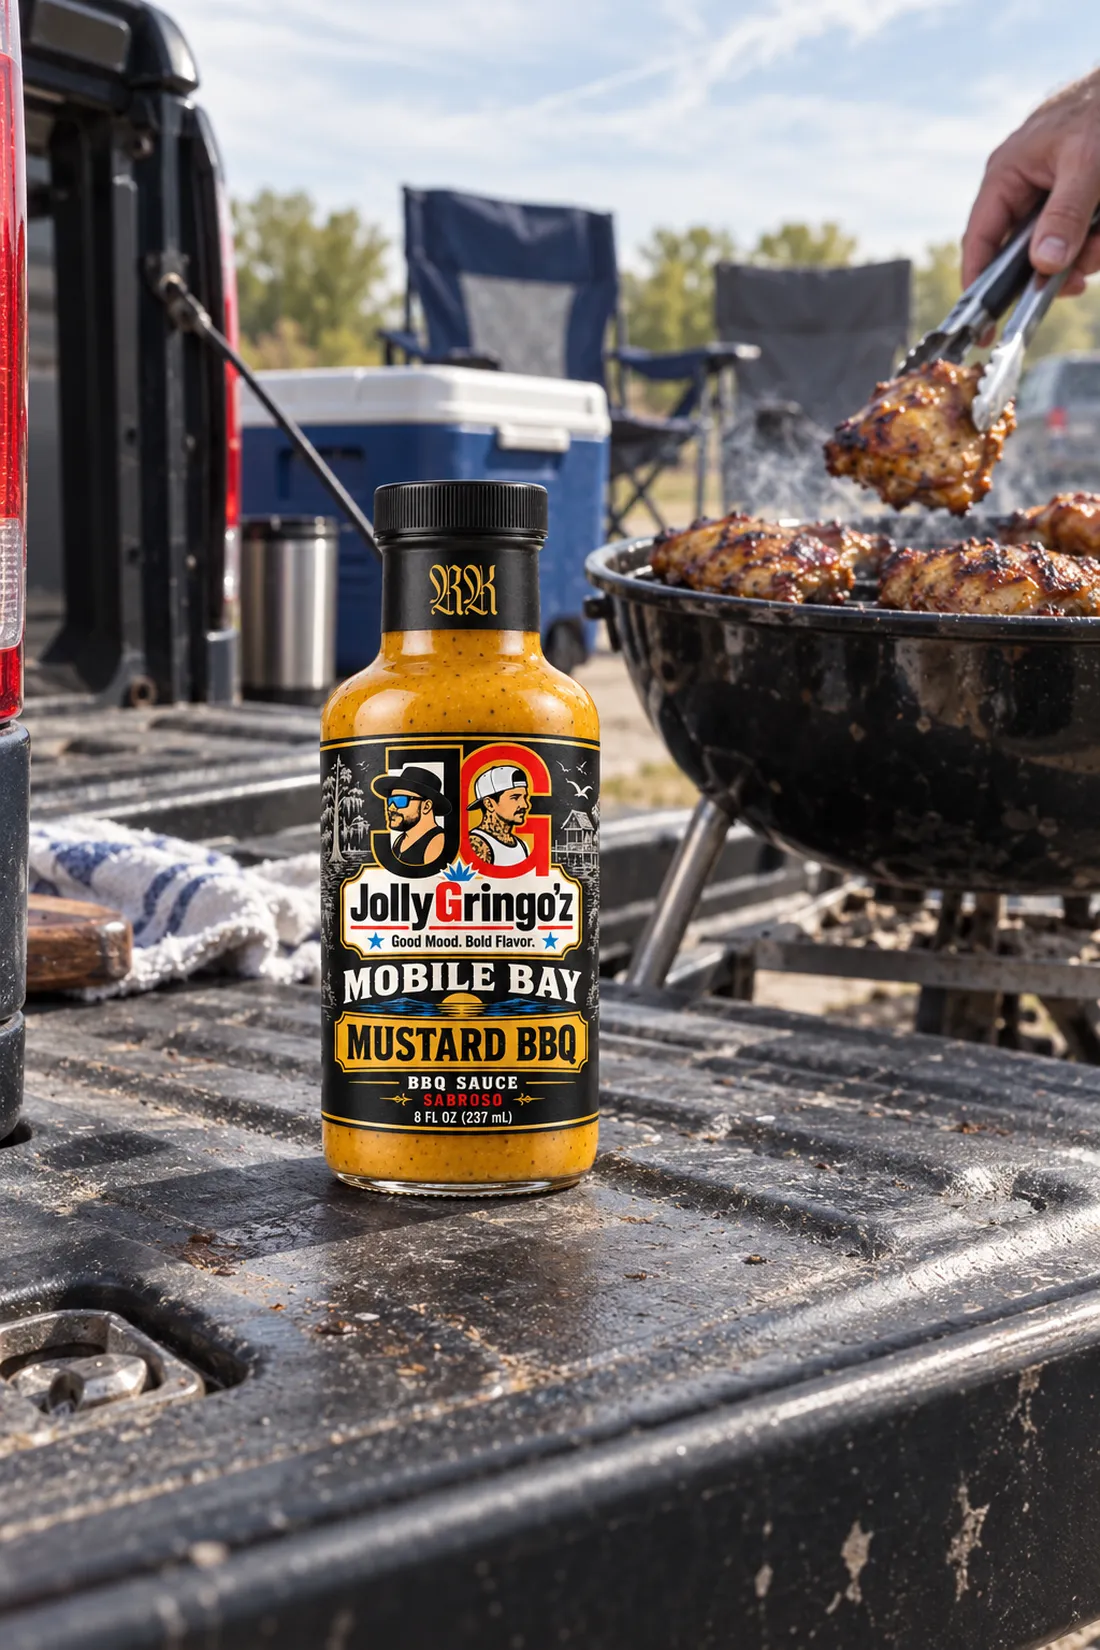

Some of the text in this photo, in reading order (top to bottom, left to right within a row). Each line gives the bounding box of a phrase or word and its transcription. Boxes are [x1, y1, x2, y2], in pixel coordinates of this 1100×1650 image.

[391, 935, 535, 948] Good Mood. Bold Flavor.
[343, 962, 582, 1004] MOBILE BAY
[347, 1023, 576, 1064] MUSTARD BBQ
[407, 1076, 518, 1091] BBQ SAUCE
[423, 1093, 503, 1107] SABROSO
[414, 1111, 512, 1125] 8 FL OZ (237 mL)
